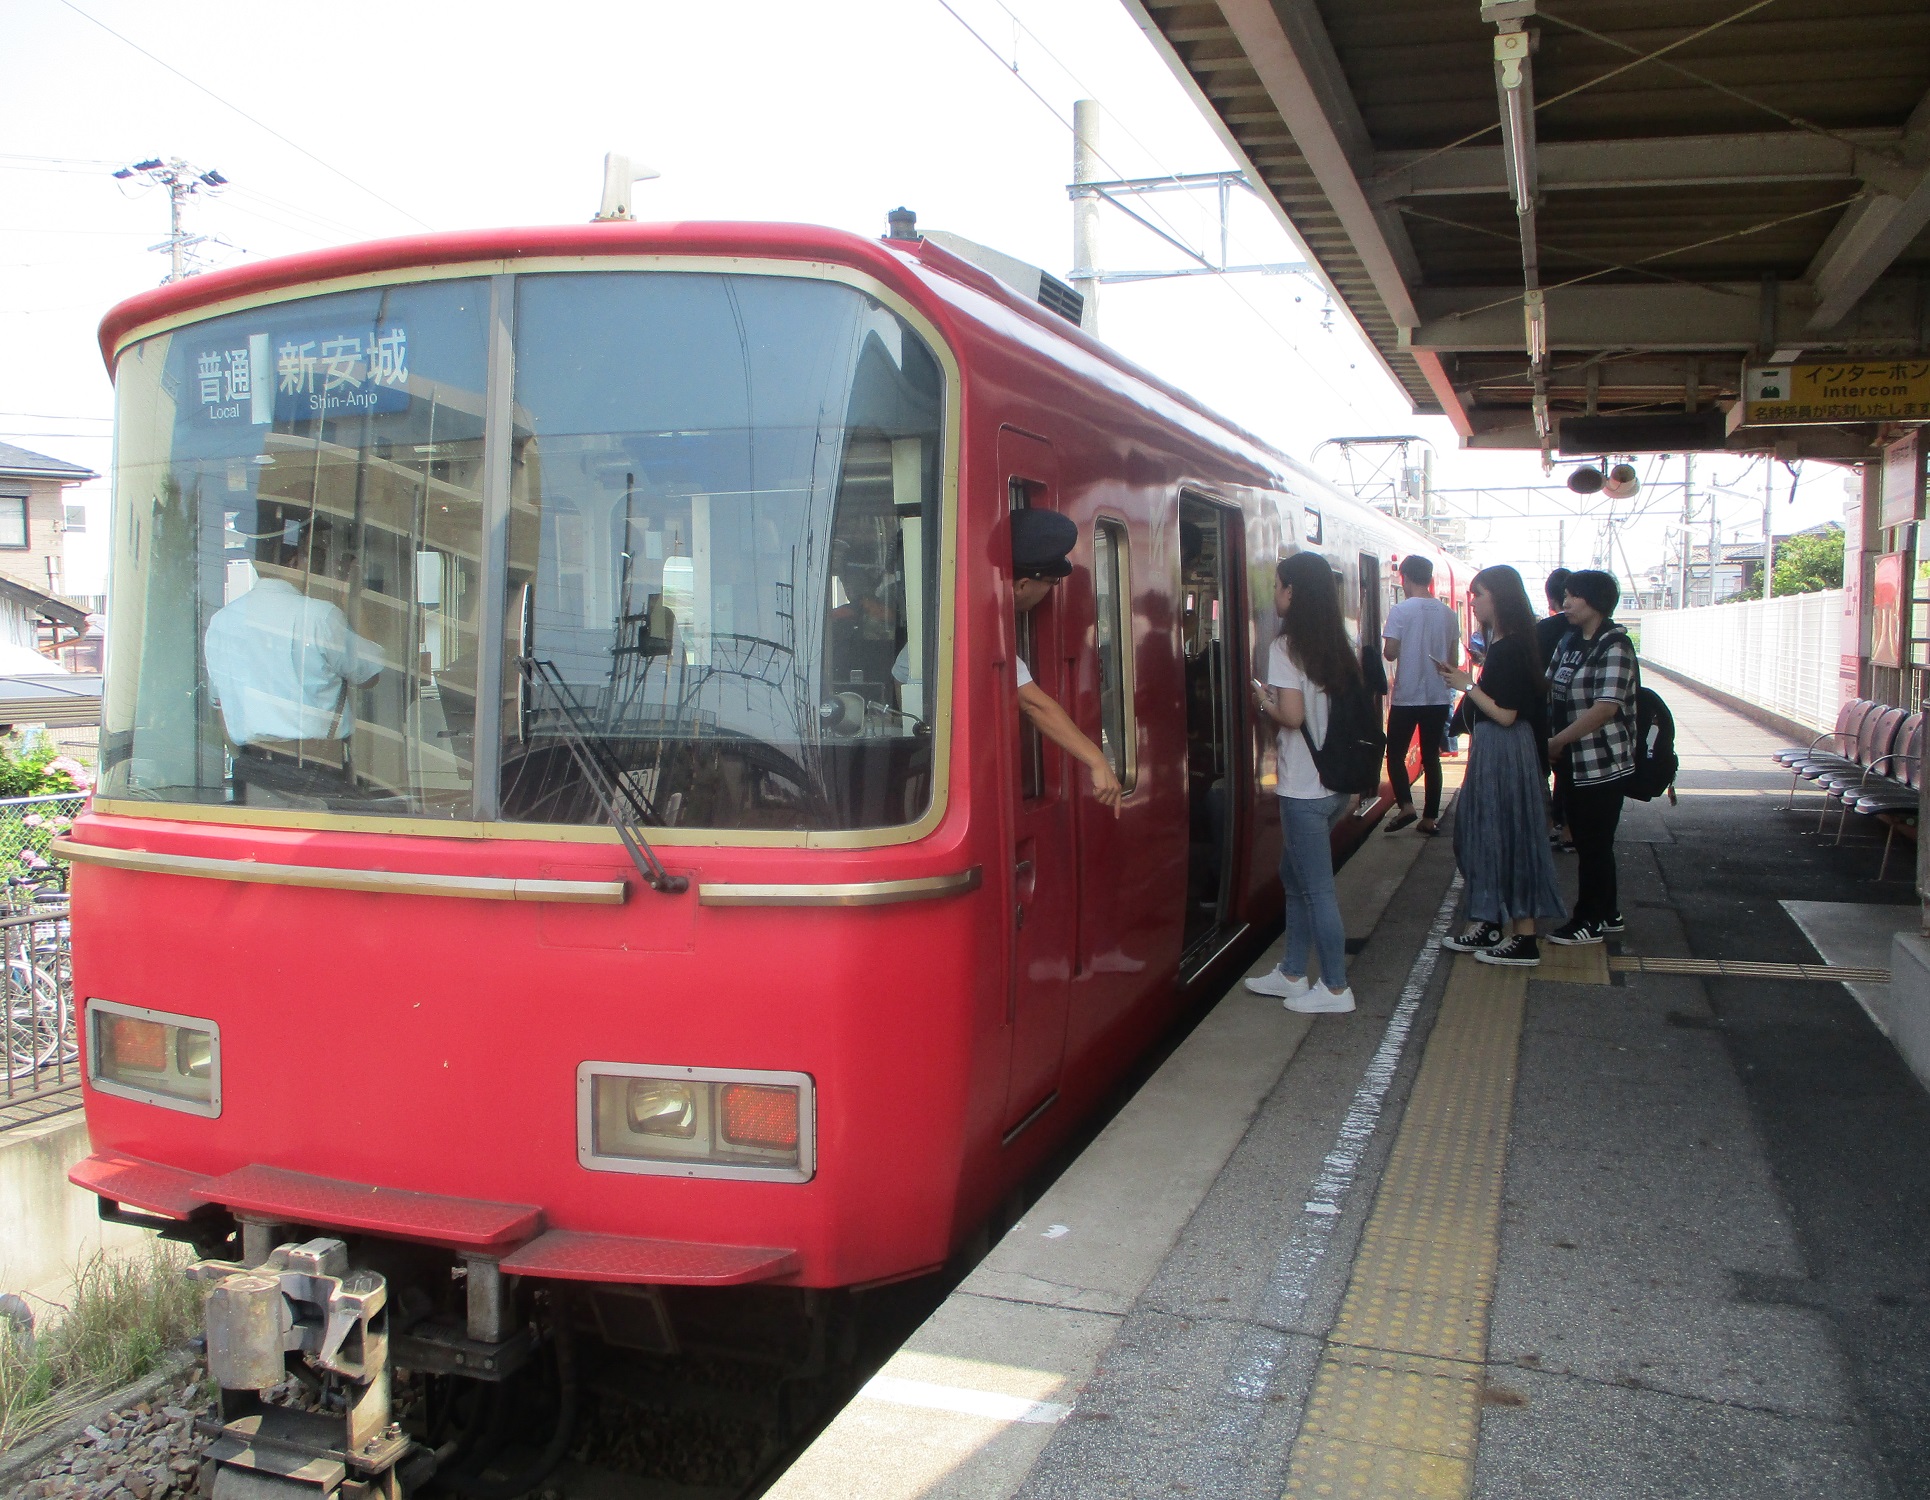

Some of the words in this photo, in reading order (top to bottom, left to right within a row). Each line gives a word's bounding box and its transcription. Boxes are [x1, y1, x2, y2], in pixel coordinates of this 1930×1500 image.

[279, 328, 409, 396] 新安城
[198, 349, 250, 404] 普通
[1805, 363, 1929, 384] インターホン
[309, 390, 378, 410] Shin-Anjo
[1823, 385, 1908, 398] Intercom
[210, 403, 240, 420] Local
